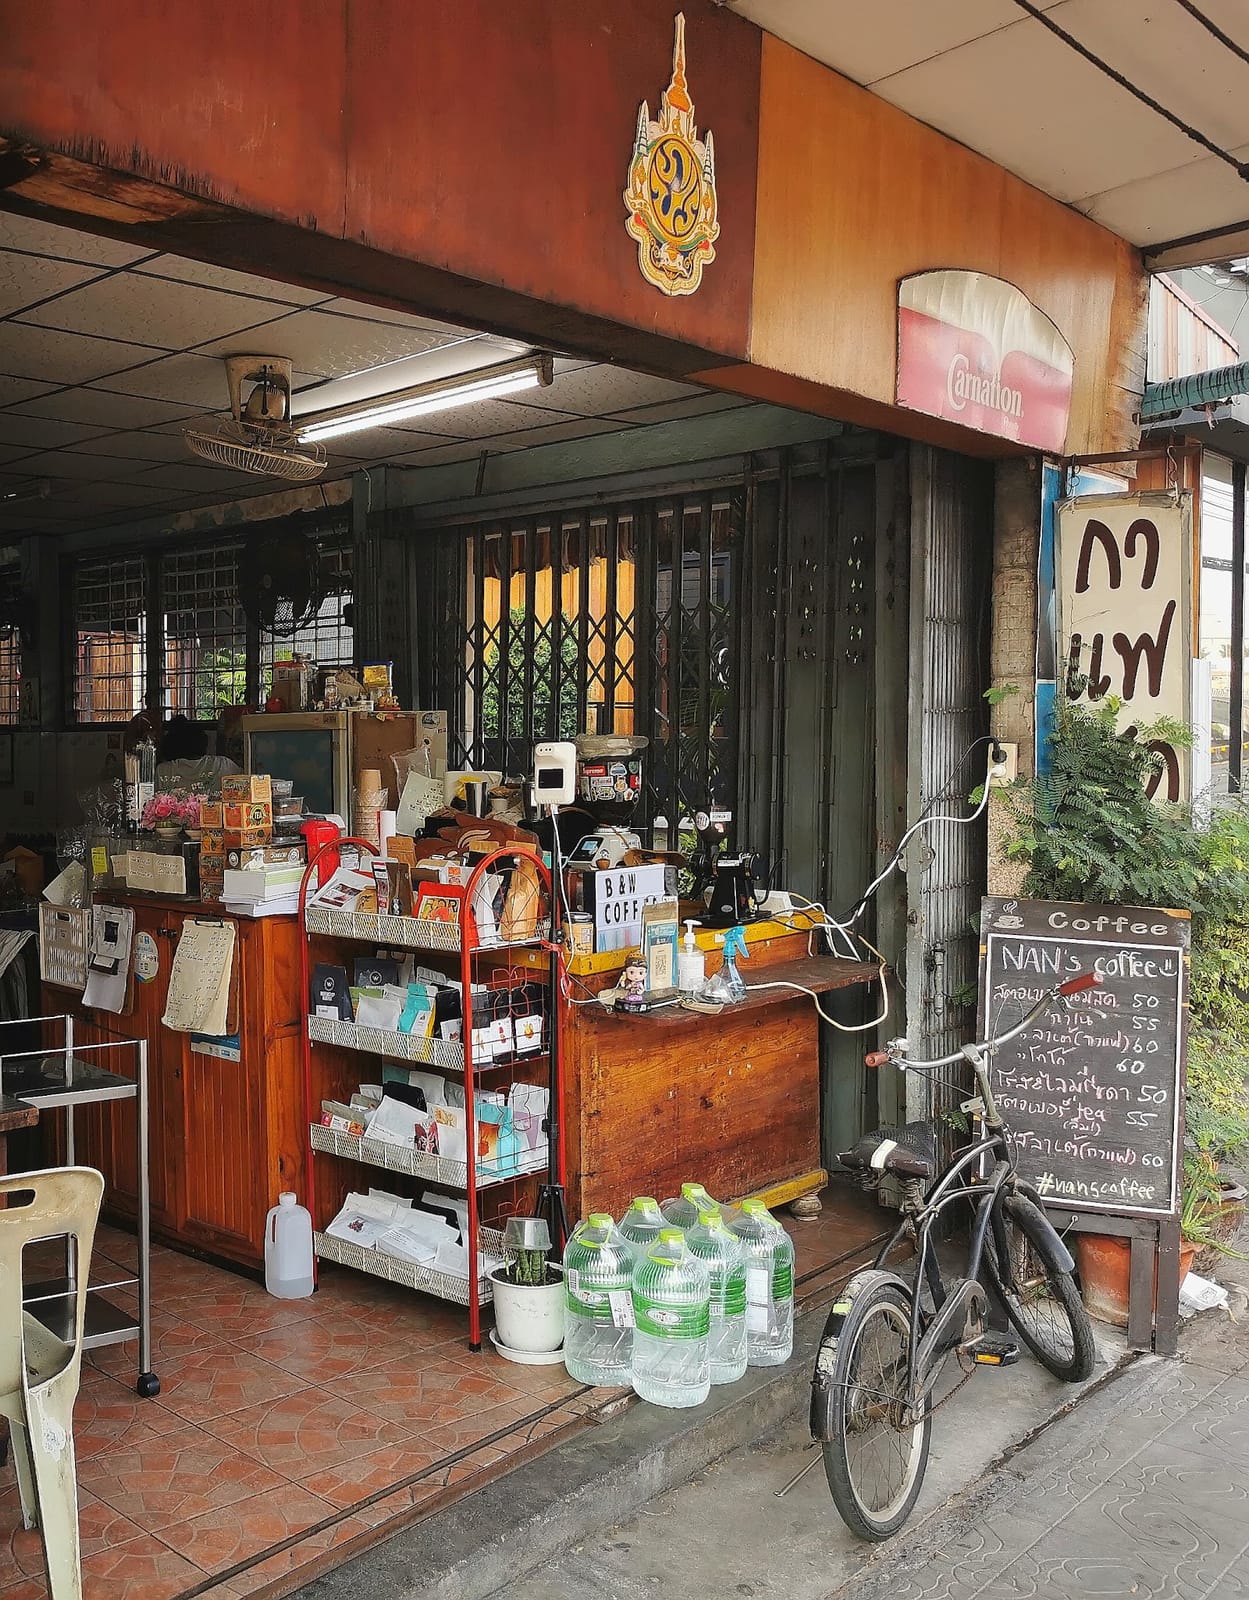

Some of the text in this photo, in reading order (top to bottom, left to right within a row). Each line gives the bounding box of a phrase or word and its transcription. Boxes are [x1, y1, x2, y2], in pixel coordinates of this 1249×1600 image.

[947, 353, 1022, 417] Carnation
[1075, 518, 1160, 593] กา
[1065, 599, 1177, 701] แฟ
[604, 873, 636, 898] B & W
[604, 896, 651, 924] COFF
[1048, 912, 1169, 936] Coffee
[1094, 950, 1158, 978] coffee
[1131, 993, 1160, 1009] 50
[1131, 1017, 1160, 1031] 55
[1132, 1037, 1160, 1053] 60
[1116, 1058, 1146, 1075] 60
[1136, 1085, 1168, 1104] 50
[1124, 1111, 1159, 1126] 55
[1141, 1154, 1164, 1168] 60
[1034, 1171, 1156, 1199] #nanscoffee
